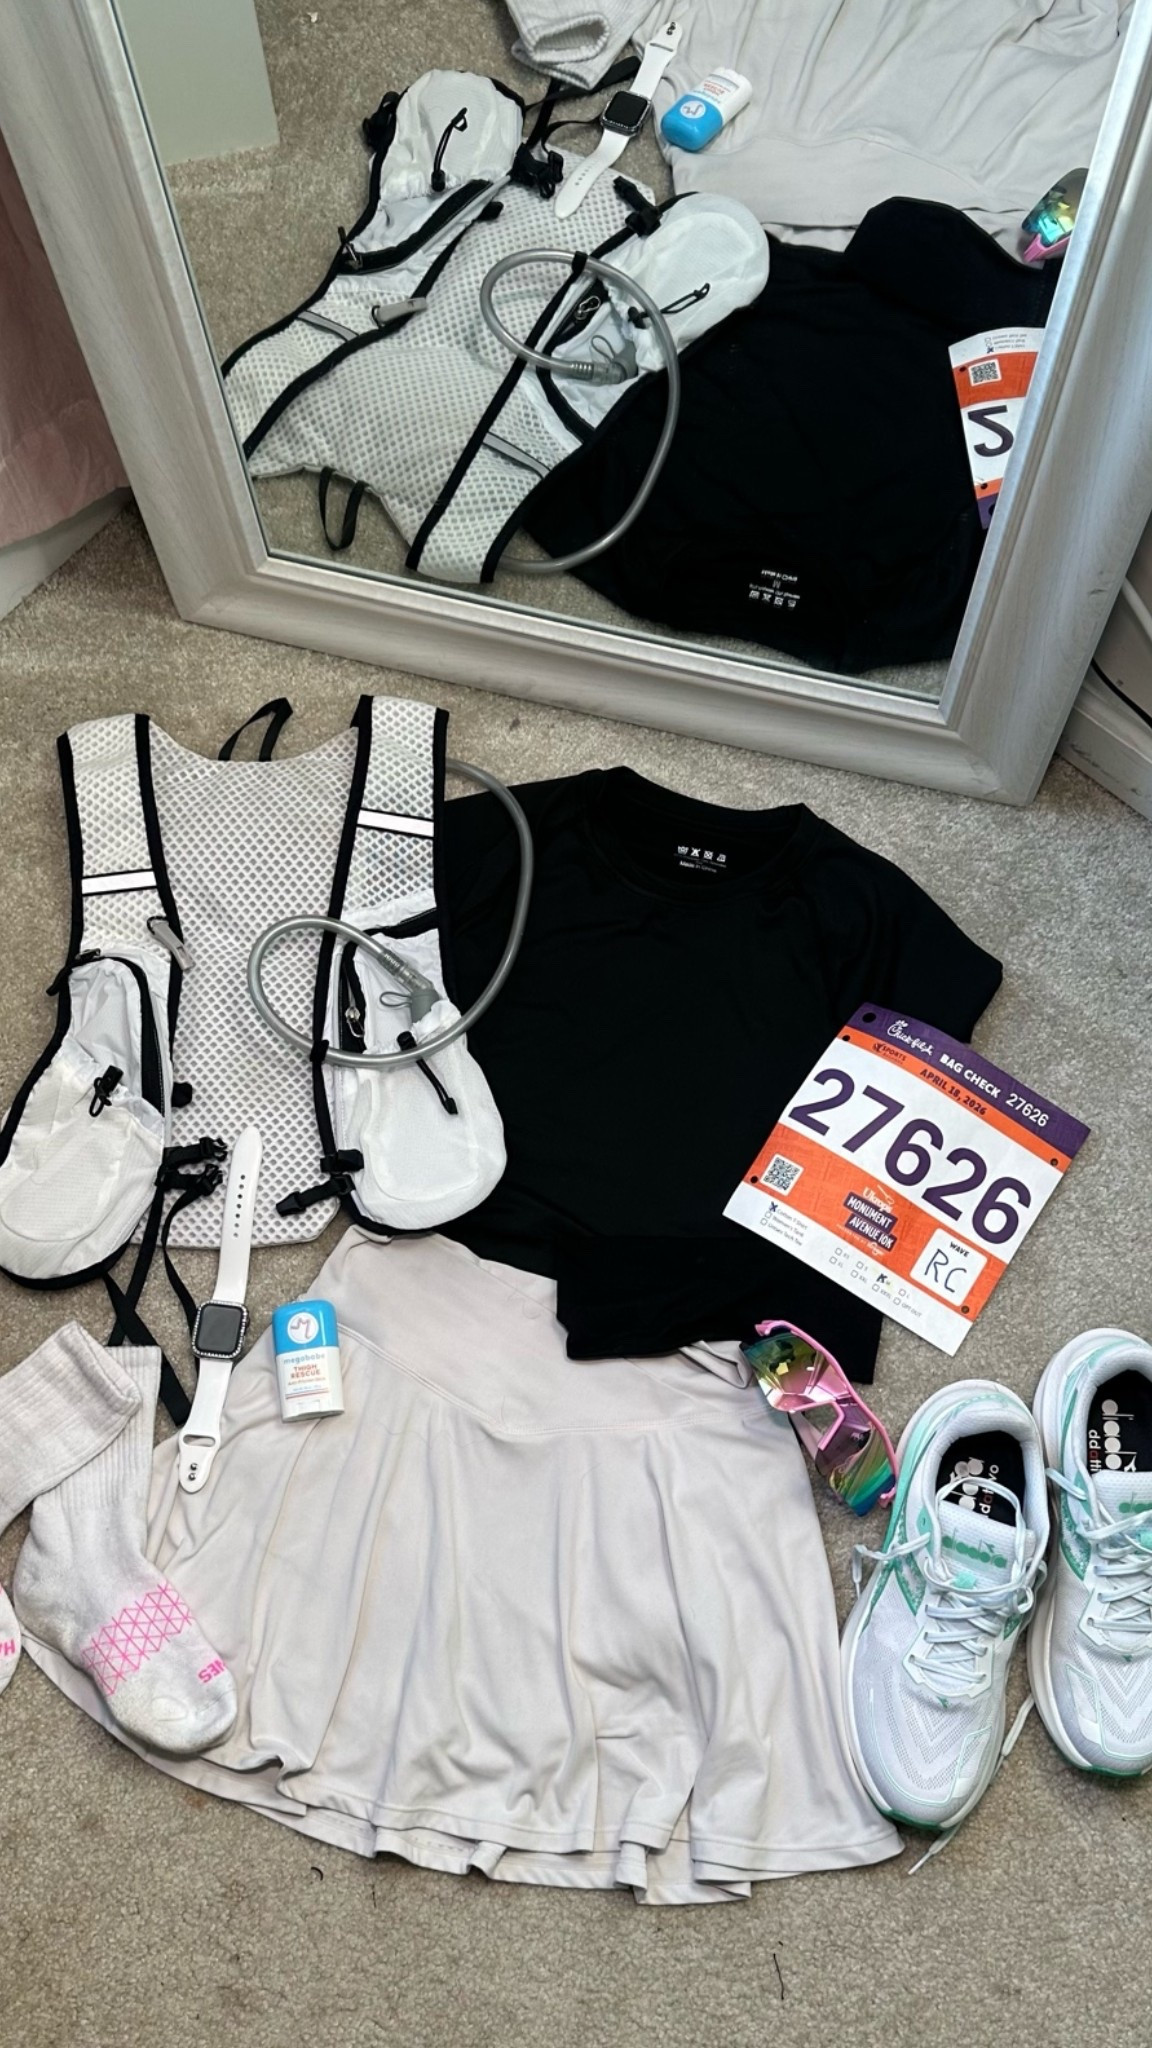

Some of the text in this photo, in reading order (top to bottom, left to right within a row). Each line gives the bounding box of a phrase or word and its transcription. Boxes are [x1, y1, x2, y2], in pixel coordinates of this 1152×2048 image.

[919, 1068, 988, 1116] APRIL 18, 2026
[939, 1053, 963, 1074] BAG
[963, 1068, 1001, 1099] CHECK
[1005, 1093, 1050, 1127] 27626
[788, 1068, 1032, 1244] 27626
[847, 1196, 893, 1229] MONUMENT
[849, 1216, 880, 1240] AVENUE
[950, 1241, 970, 1257] WAVE
[924, 1248, 967, 1293] RC
[291, 1369, 320, 1379] RESCUE
[294, 1363, 317, 1372] THIGH
